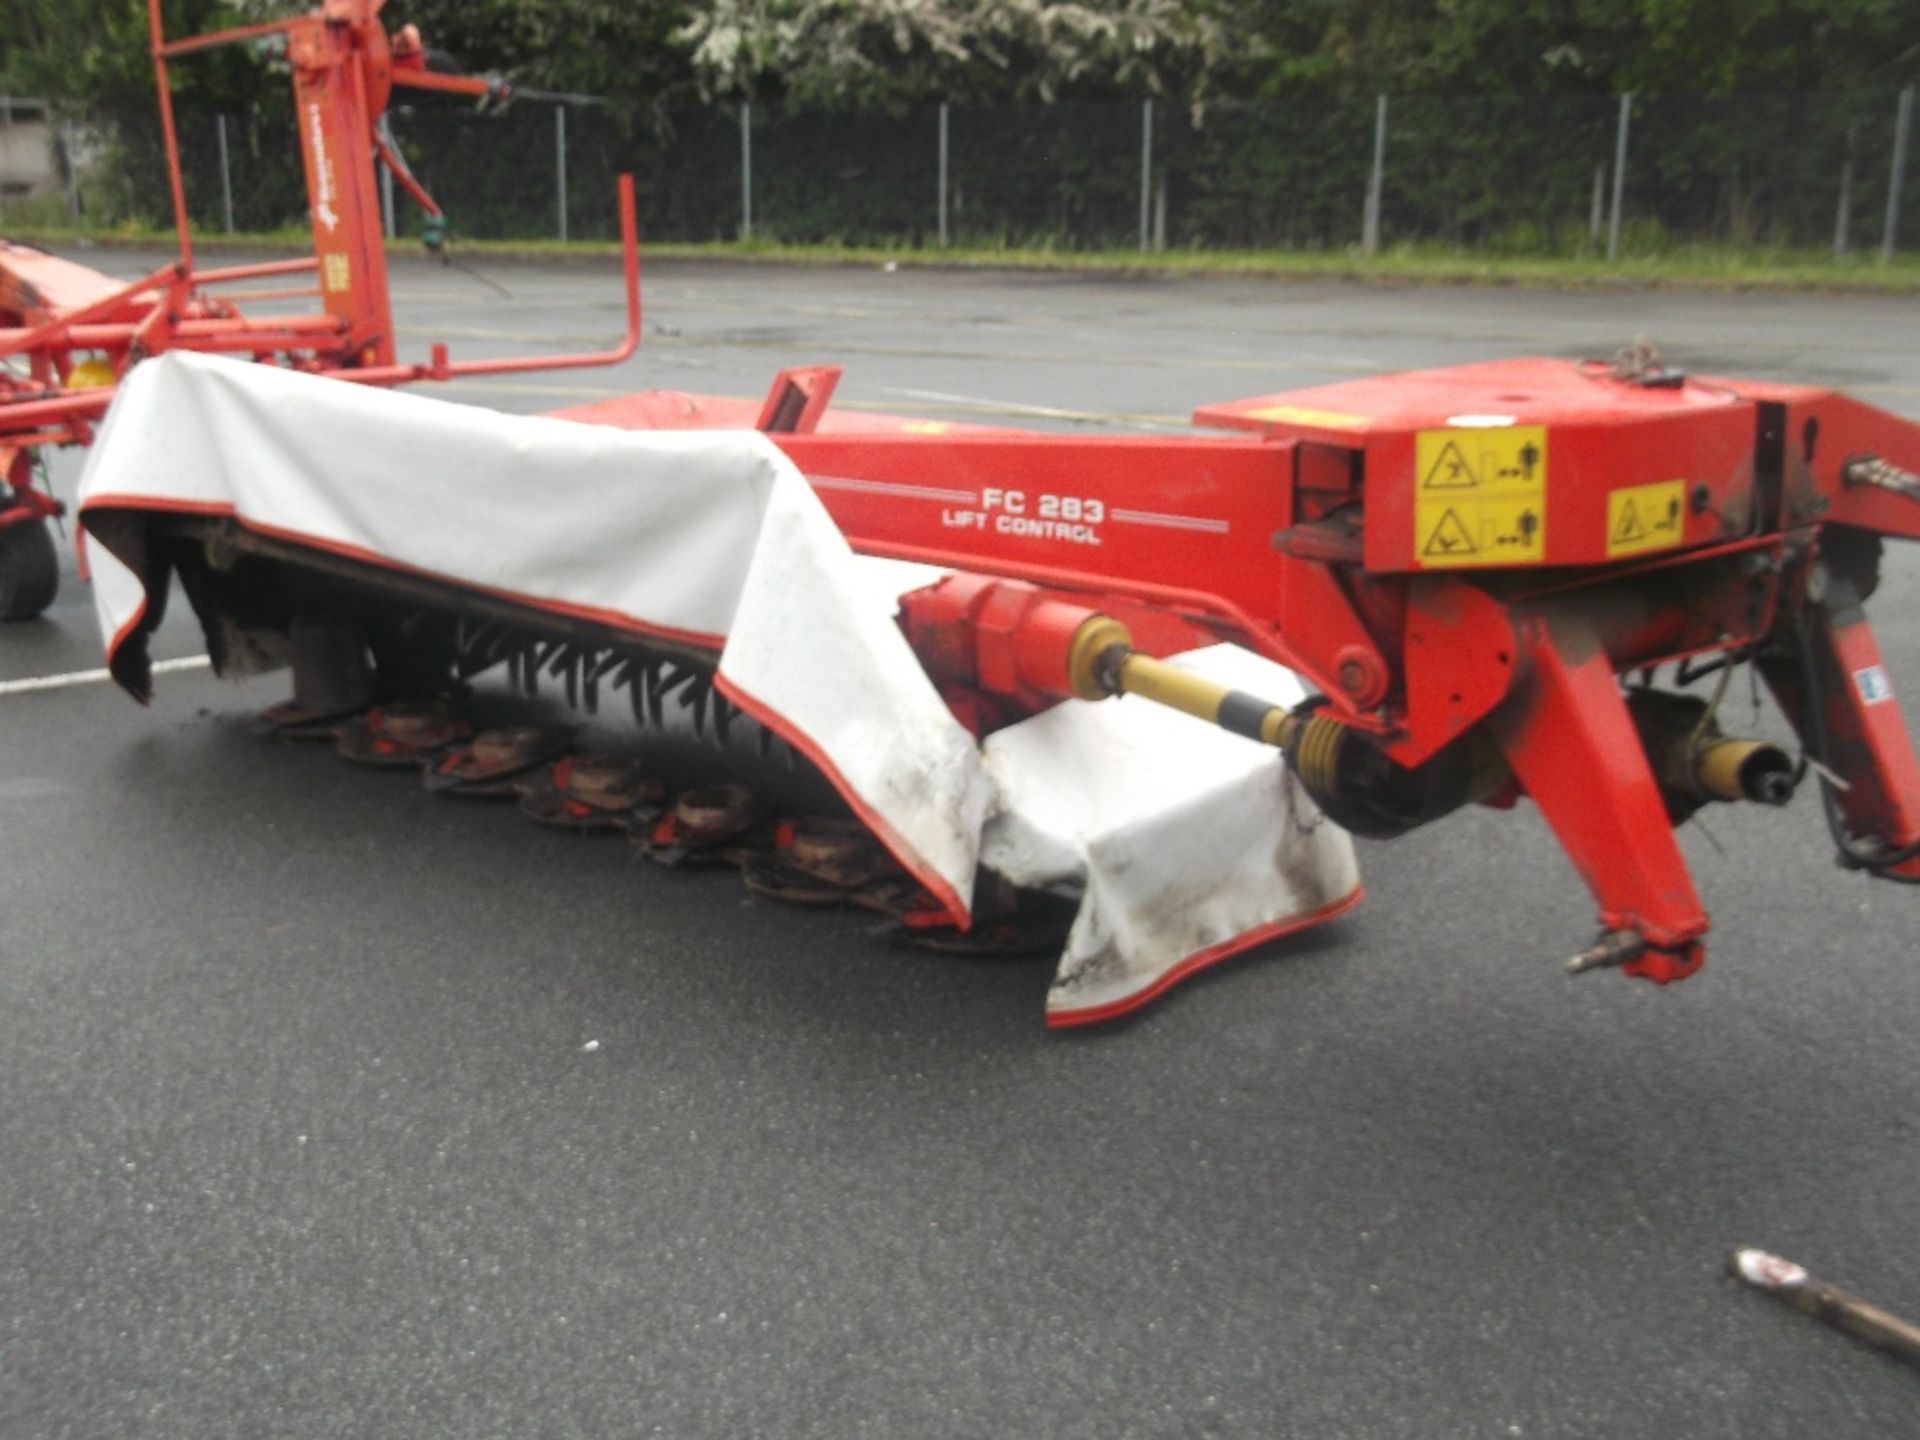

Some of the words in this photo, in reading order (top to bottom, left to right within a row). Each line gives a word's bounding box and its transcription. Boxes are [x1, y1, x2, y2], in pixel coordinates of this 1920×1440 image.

[983, 488, 1026, 514] FC
[1039, 494, 1104, 522] 283
[943, 509, 988, 530] LIFT
[996, 516, 1101, 544] CONTROL
